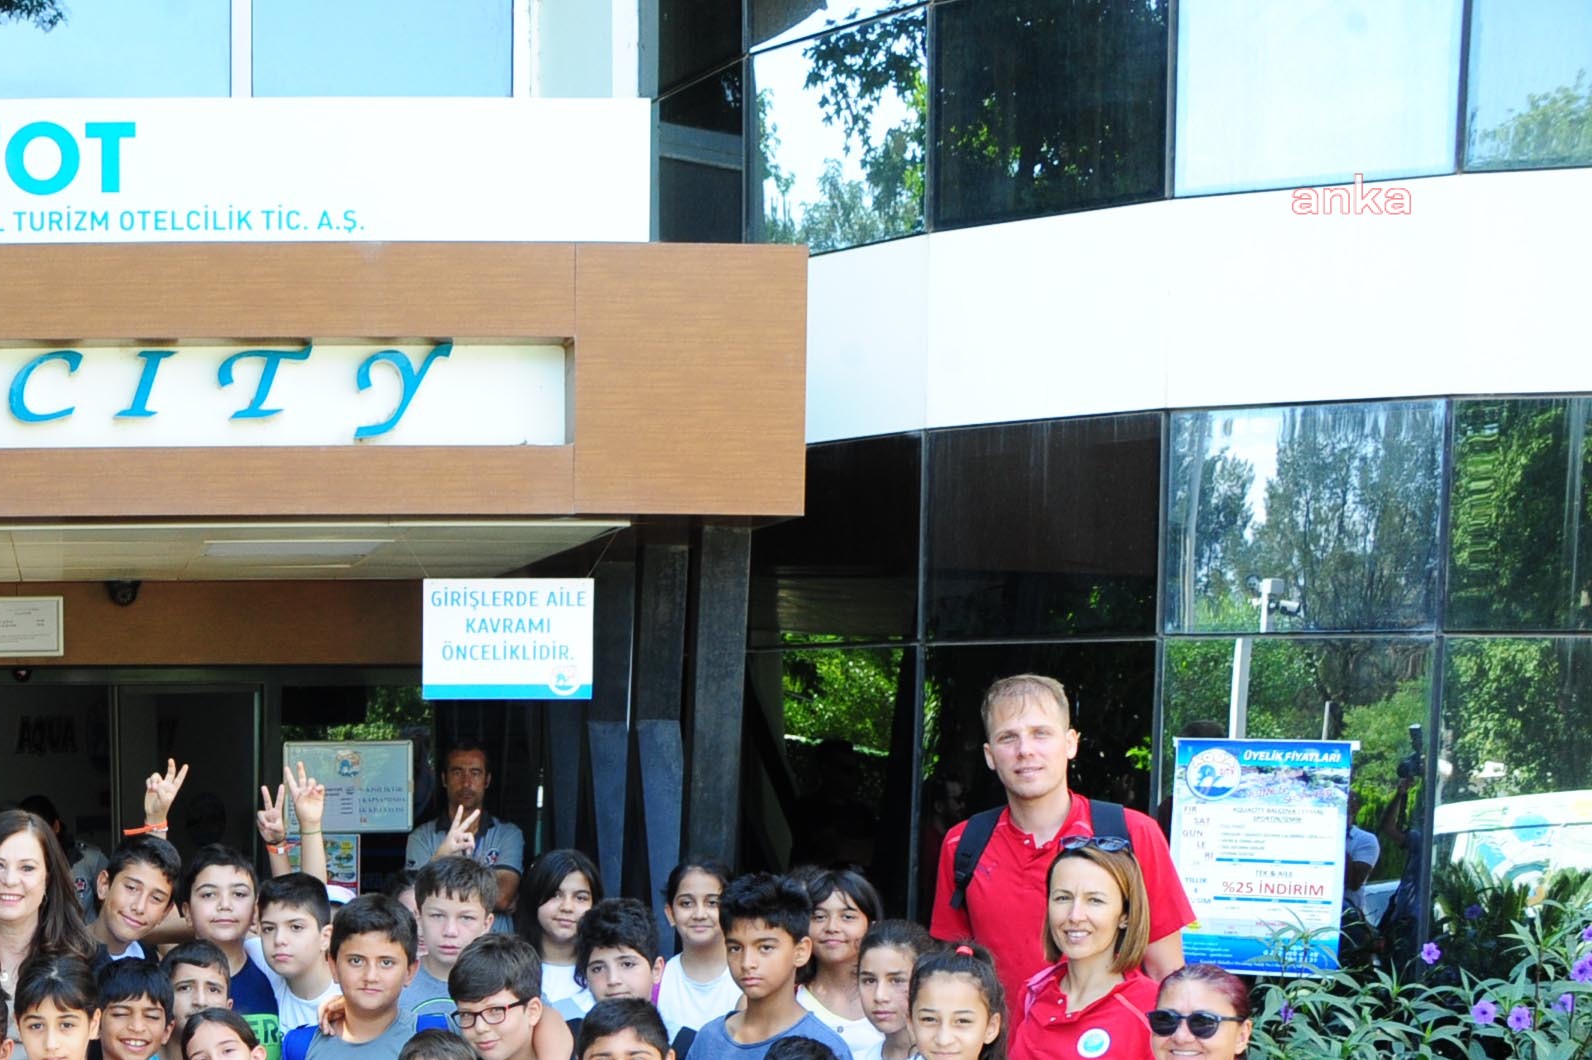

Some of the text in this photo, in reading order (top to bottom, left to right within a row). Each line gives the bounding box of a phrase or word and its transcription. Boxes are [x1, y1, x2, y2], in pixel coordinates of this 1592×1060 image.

[12, 205, 109, 234] TURİZM
[119, 203, 252, 233] OTELCİLİK
[260, 203, 309, 232] TİC.
[315, 207, 366, 237] A.Ş.
[430, 586, 587, 611] GİRİŞLERDE AİLE
[465, 617, 551, 634] KAVRAMI
[441, 640, 575, 661] ÖNCELİKLİDİR.
[1243, 749, 1342, 763] ÜYELİK FİYATLARI
[1222, 879, 1325, 897] %25 İNDİRİM
